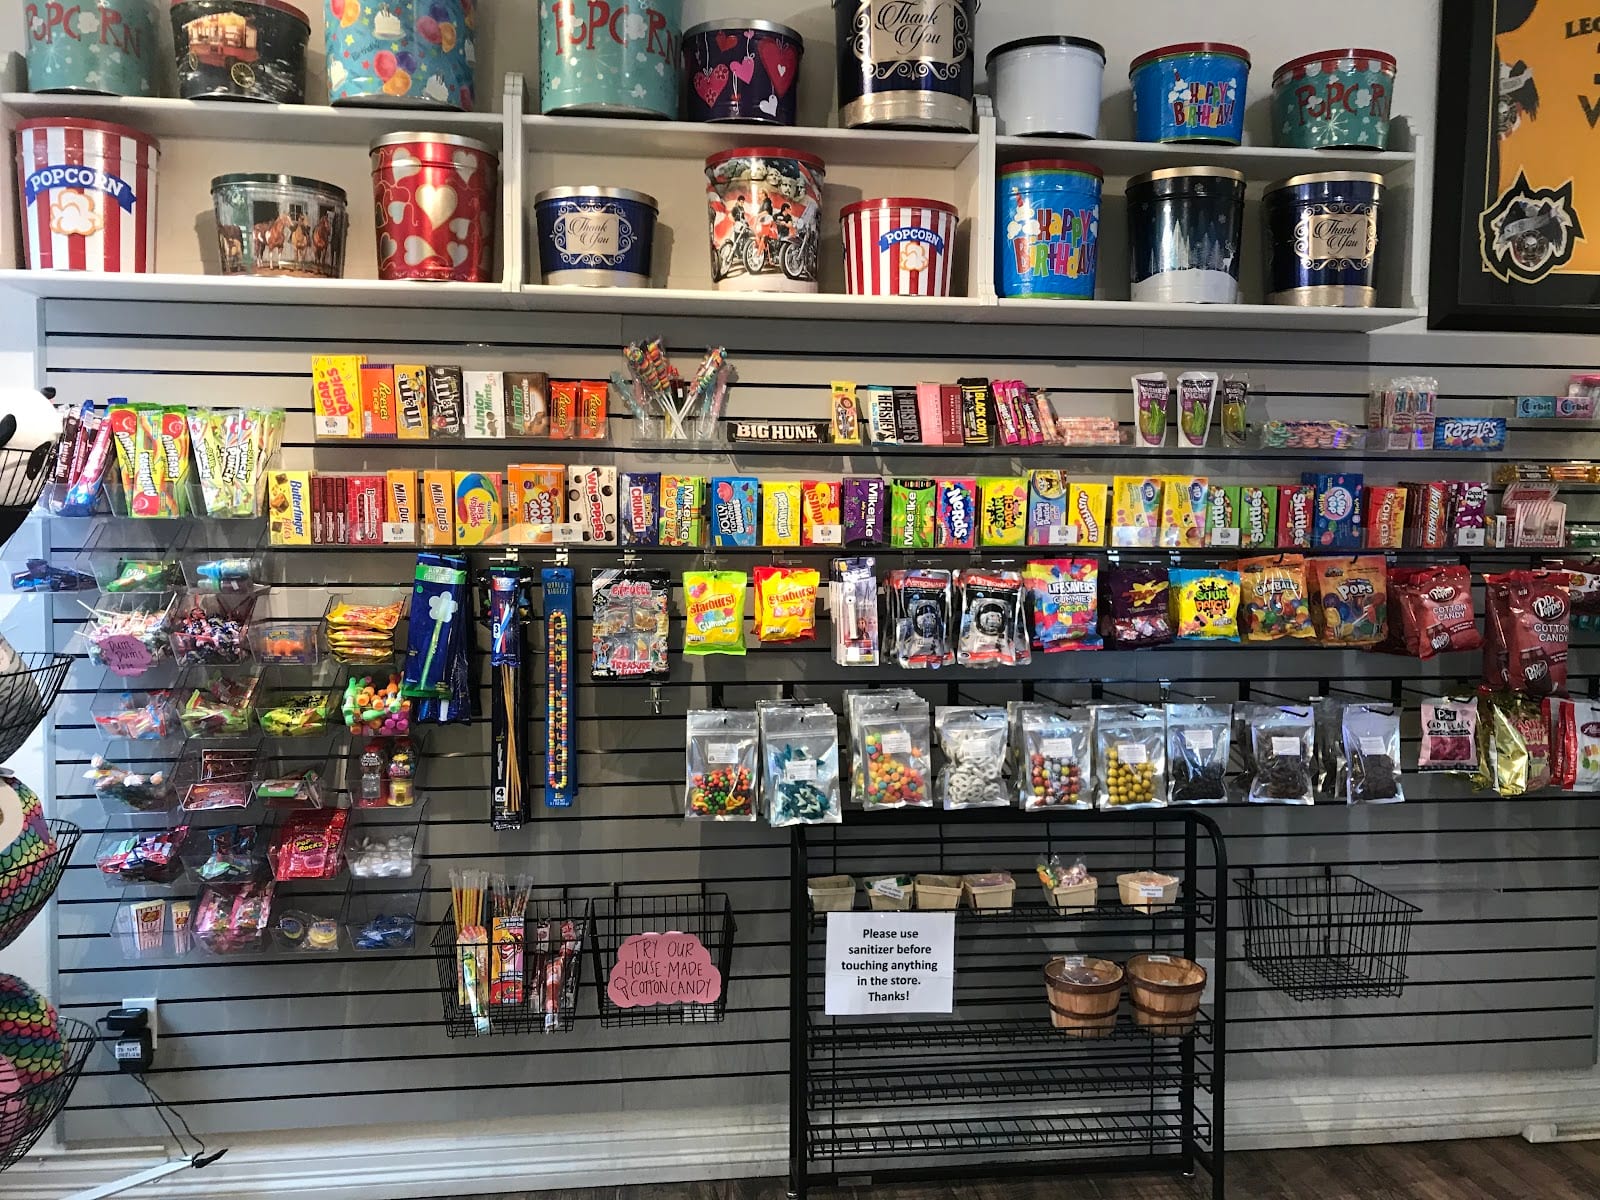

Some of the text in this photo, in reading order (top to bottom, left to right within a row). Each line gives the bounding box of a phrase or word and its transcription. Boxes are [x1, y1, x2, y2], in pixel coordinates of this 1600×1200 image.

[894, 23, 941, 54] You
[30, 167, 124, 196] POPCORN
[566, 218, 608, 234] Thank
[885, 229, 941, 247] POPCORN
[1313, 216, 1358, 238] Thank
[579, 232, 610, 248] You
[1326, 235, 1360, 252] You
[318, 381, 338, 416] UGAR
[327, 368, 354, 415] BABIES
[474, 390, 487, 435] Junior
[512, 385, 525, 436] Junior
[878, 395, 896, 439] HERSHEY'S
[900, 399, 919, 441] HERSHEY'S
[974, 392, 987, 436] BLACK COW
[736, 424, 818, 439] BIG HUNK
[197, 445, 211, 478] PUNCH
[222, 446, 238, 483] PUNCH
[237, 443, 249, 480] PUNCH
[290, 480, 304, 537] Butterfinger
[393, 482, 406, 508] Milk
[431, 483, 449, 533] Milk Duds
[470, 495, 480, 529] Swedish
[529, 499, 541, 524] POP
[631, 488, 645, 531] CRUNCH
[717, 504, 731, 534] JOLLY
[995, 497, 1004, 530] SOUR
[1005, 495, 1014, 530] PATCH
[1078, 490, 1098, 543] JUJYFRUITS
[1250, 489, 1264, 543] Skittles
[1292, 492, 1305, 546] Skittles
[1381, 491, 1396, 546] RED HOTS
[1047, 581, 1097, 594] LIFE SAVERS
[1196, 590, 1228, 600] SOUR
[1197, 600, 1230, 610] PATCH
[1433, 604, 1467, 614] COTTON
[1438, 611, 1465, 621] CANDY
[495, 625, 499, 634] 3
[1539, 633, 1568, 642] CANDY
[554, 622, 563, 672] CANDY
[296, 838, 311, 847] POP
[299, 841, 324, 851] ROCKS
[863, 928, 919, 939] Please use
[629, 940, 695, 958] TRY OUR
[848, 944, 932, 955] sanitizer before
[841, 960, 938, 972] touching anything
[631, 978, 713, 998] COTTON CANDY
[857, 975, 921, 986] in the store.
[868, 990, 910, 1002] Thanks!
